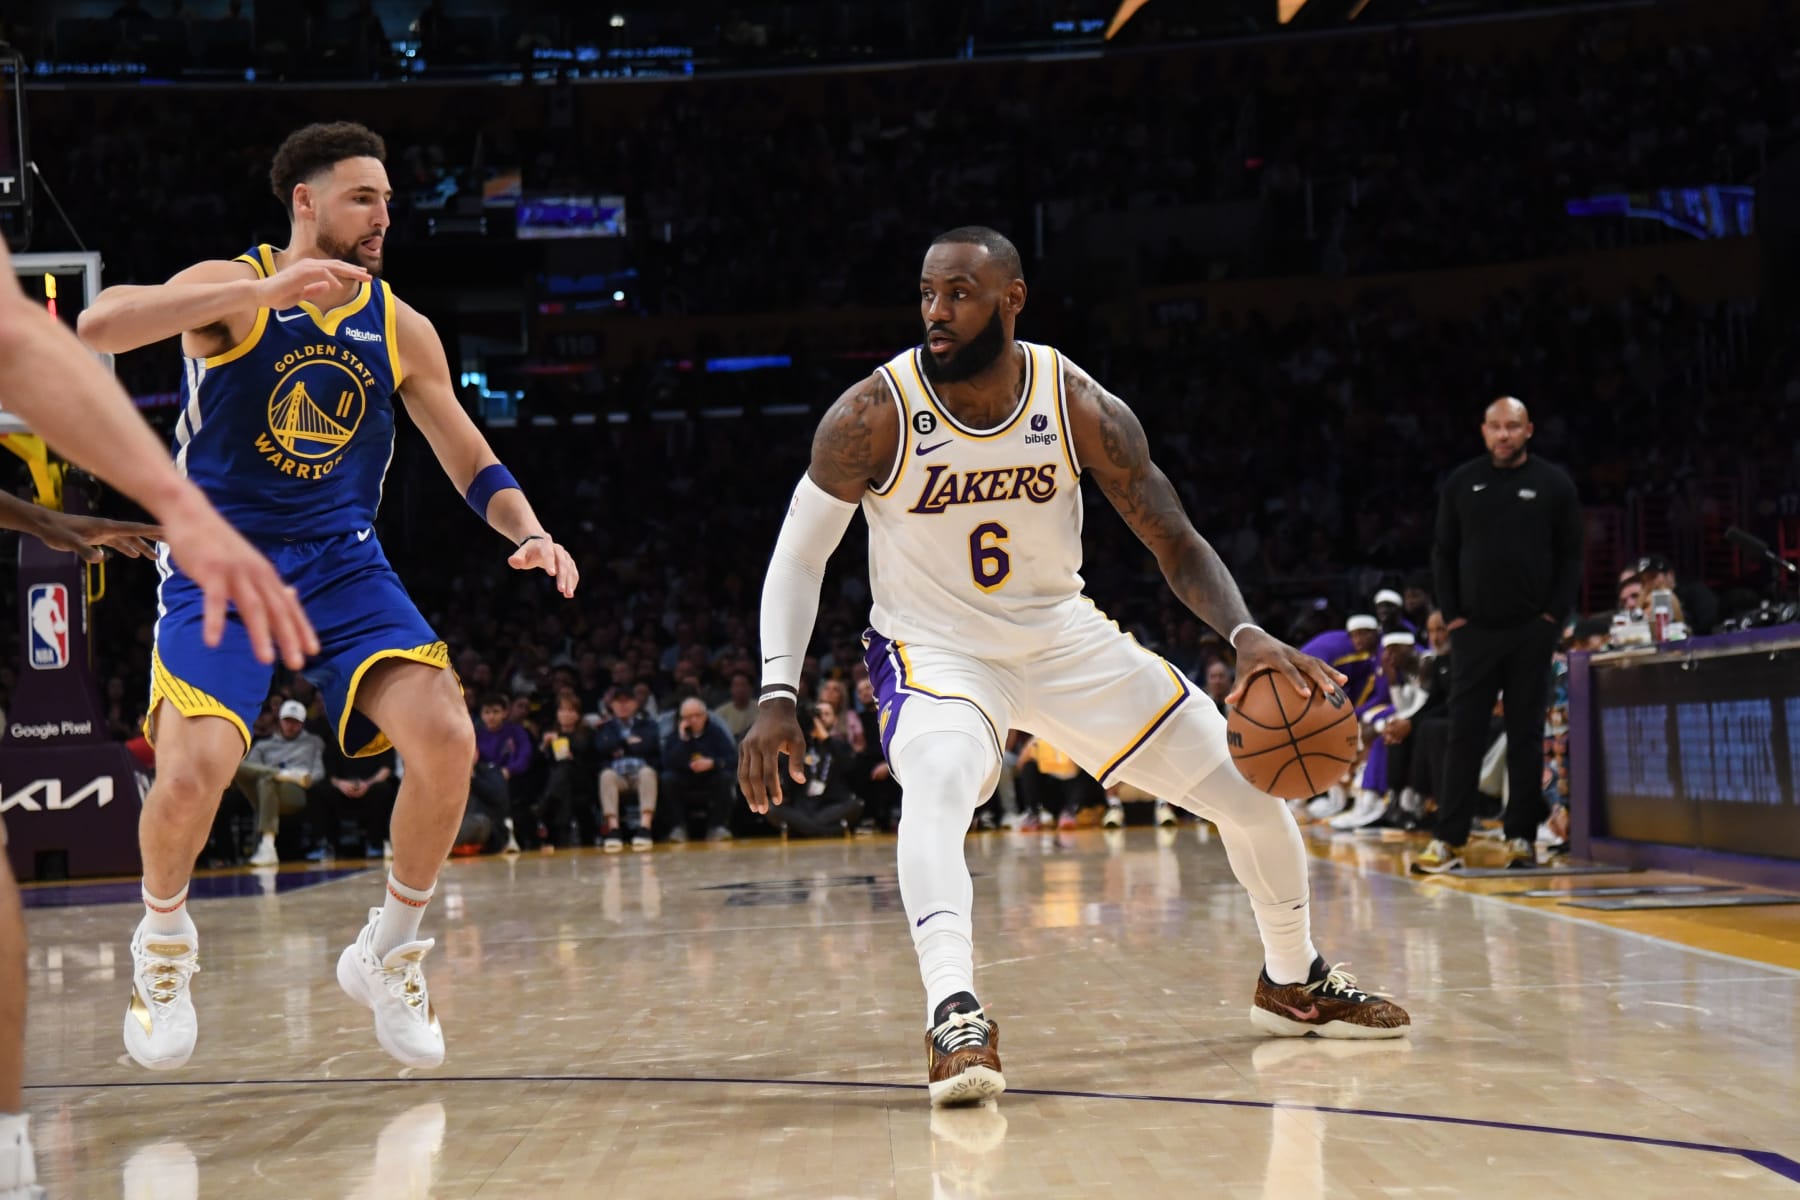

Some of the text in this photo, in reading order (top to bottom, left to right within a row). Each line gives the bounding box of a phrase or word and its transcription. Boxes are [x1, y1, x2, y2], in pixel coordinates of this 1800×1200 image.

[345, 326, 382, 343] Rakuten
[274, 344, 376, 388] GOLDEN STATE
[918, 413, 932, 432] 6
[1025, 433, 1057, 445] bibigo
[907, 463, 1058, 514] LAKERS
[968, 520, 1012, 594] 6
[11, 720, 91, 739] Google Pixel
